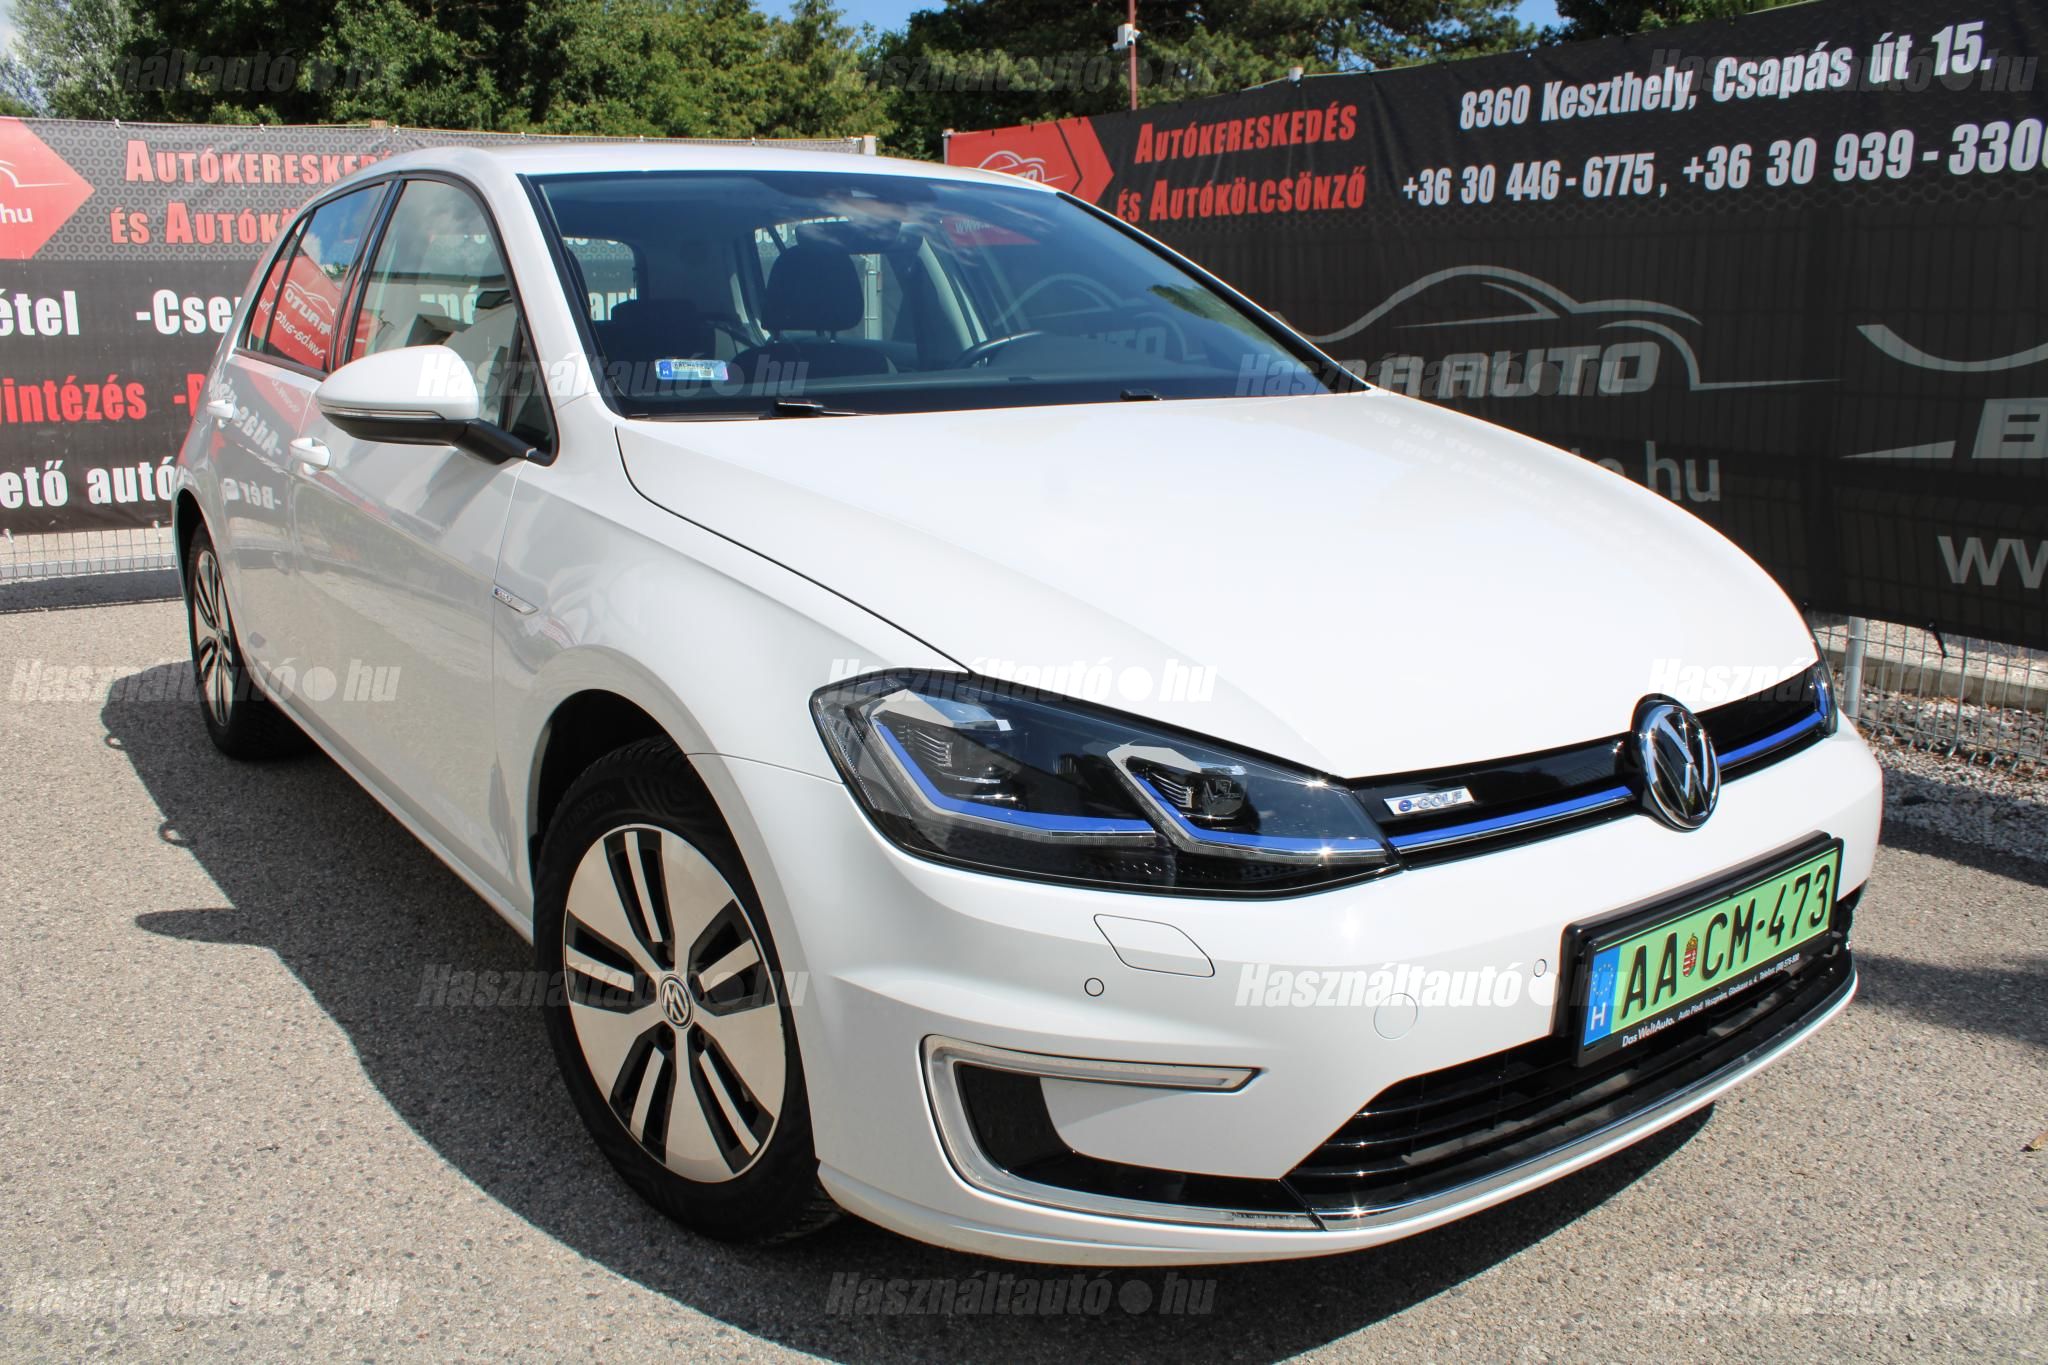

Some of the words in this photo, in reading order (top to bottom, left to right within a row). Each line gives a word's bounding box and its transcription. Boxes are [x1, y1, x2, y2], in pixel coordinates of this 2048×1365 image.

[1460, 84, 1532, 131] 8360
[1540, 66, 1698, 122] Keszthely,
[1712, 40, 1854, 103] Csapás
[1868, 32, 1913, 84] út
[1930, 20, 1992, 77] 15.
[1402, 167, 1453, 207] +36
[1460, 164, 1497, 204] 30
[1682, 143, 1752, 192] +36
[1765, 137, 1818, 187] 30
[0, 373, 148, 424] intézés
[1436, 341, 1661, 400] AUTO
[1620, 931, 1679, 1020] AA
[1701, 864, 1831, 981] CM-473
[1590, 1002, 1608, 1031] H
[1621, 1034, 1639, 1048] Das
